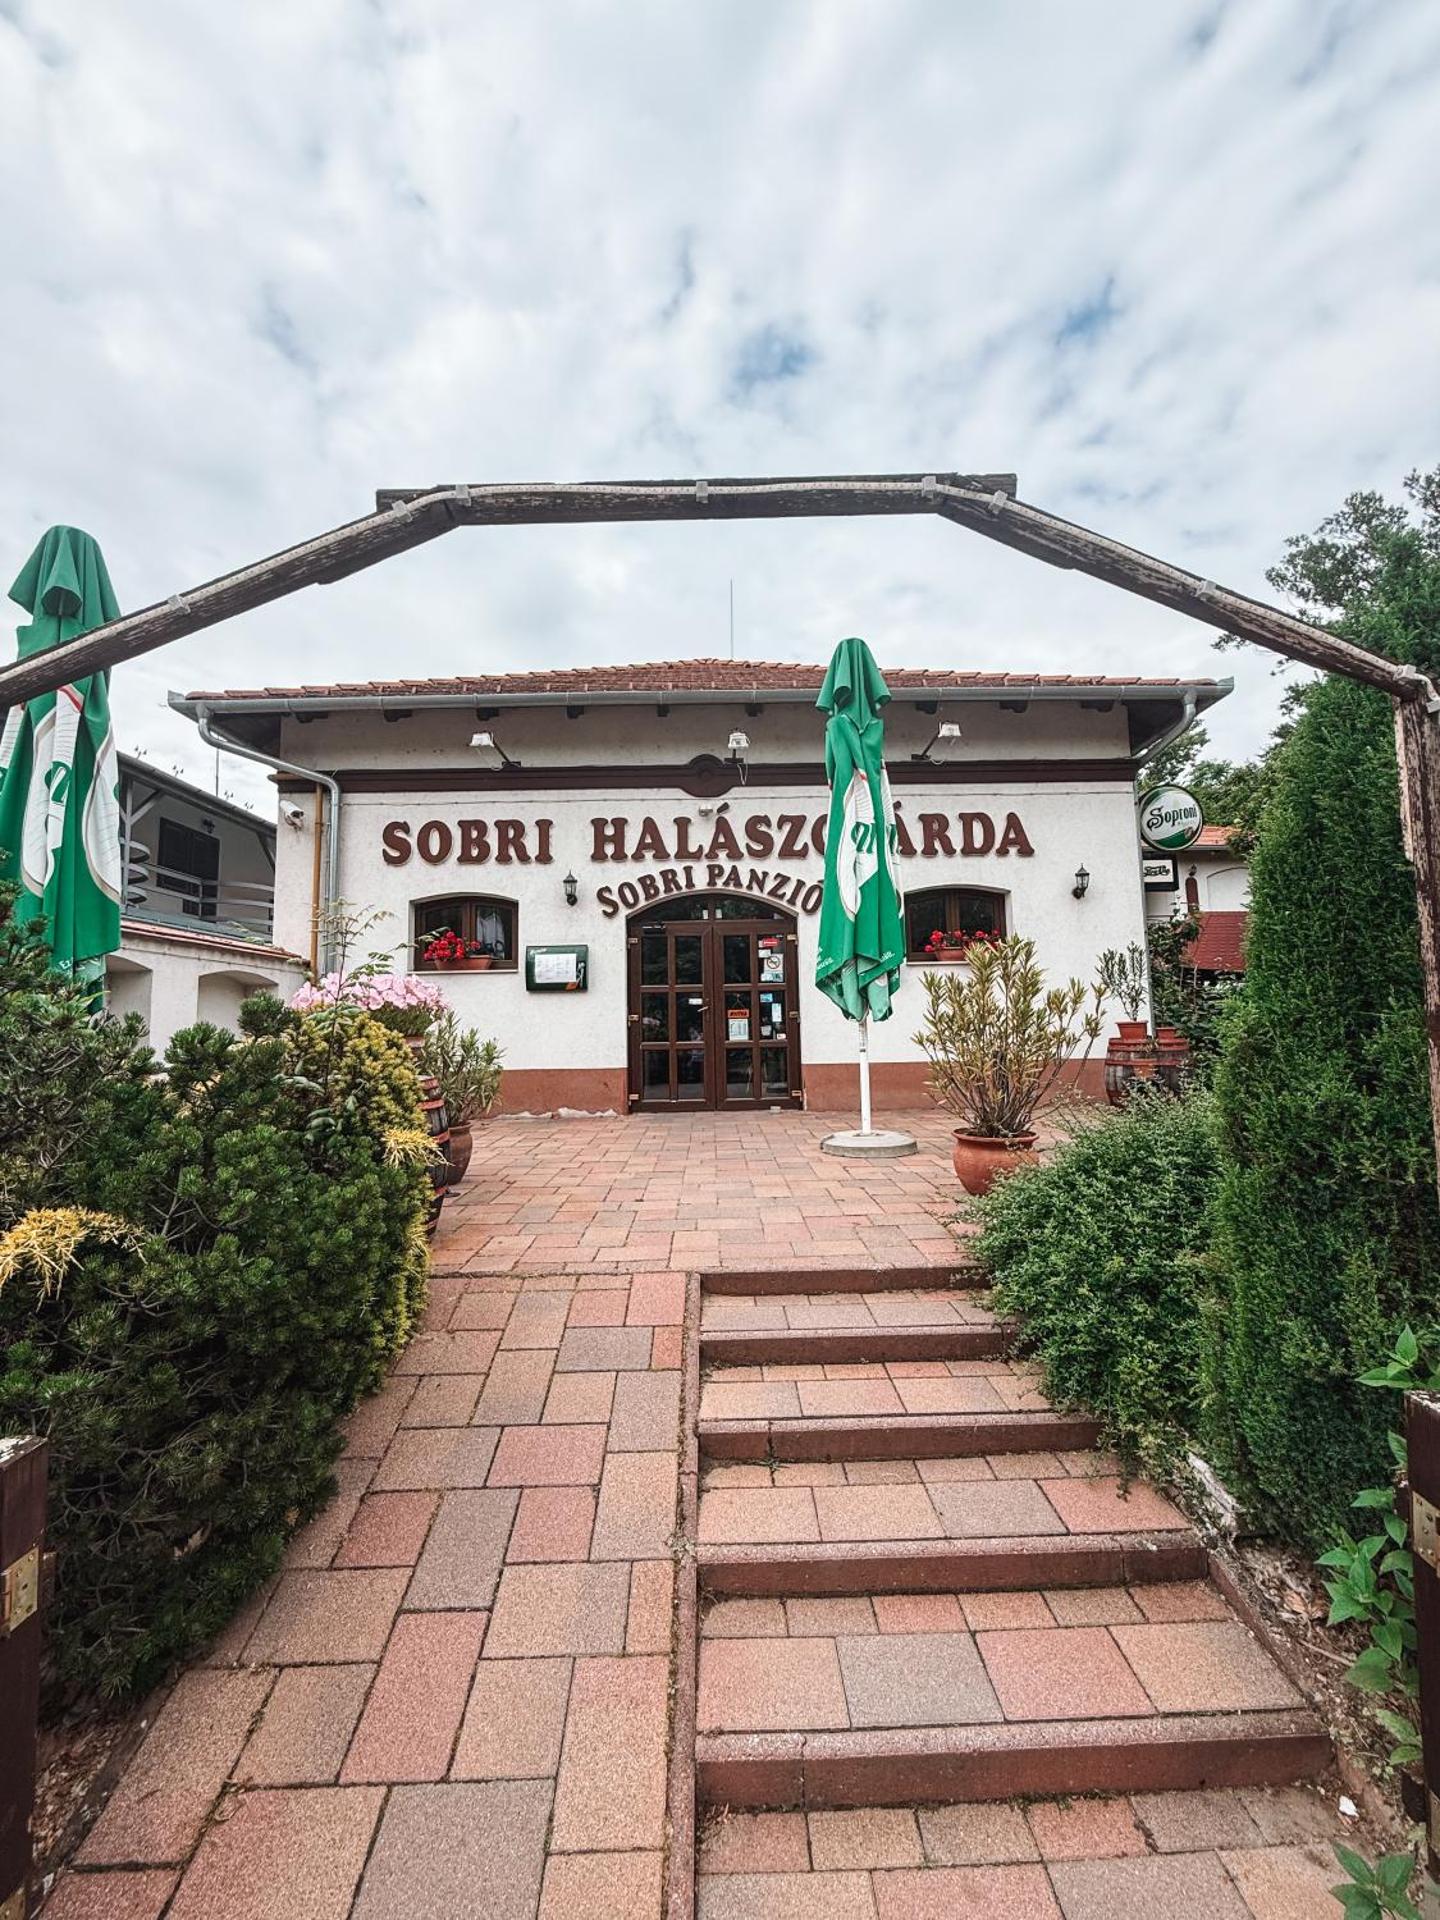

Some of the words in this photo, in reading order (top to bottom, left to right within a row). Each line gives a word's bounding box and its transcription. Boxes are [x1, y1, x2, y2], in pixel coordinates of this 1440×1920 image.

[1146, 804, 1198, 832] Soproni
[382, 819, 554, 865] SOBRI
[596, 865, 695, 918] SOBRI
[706, 863, 824, 914] PANZIÓ
